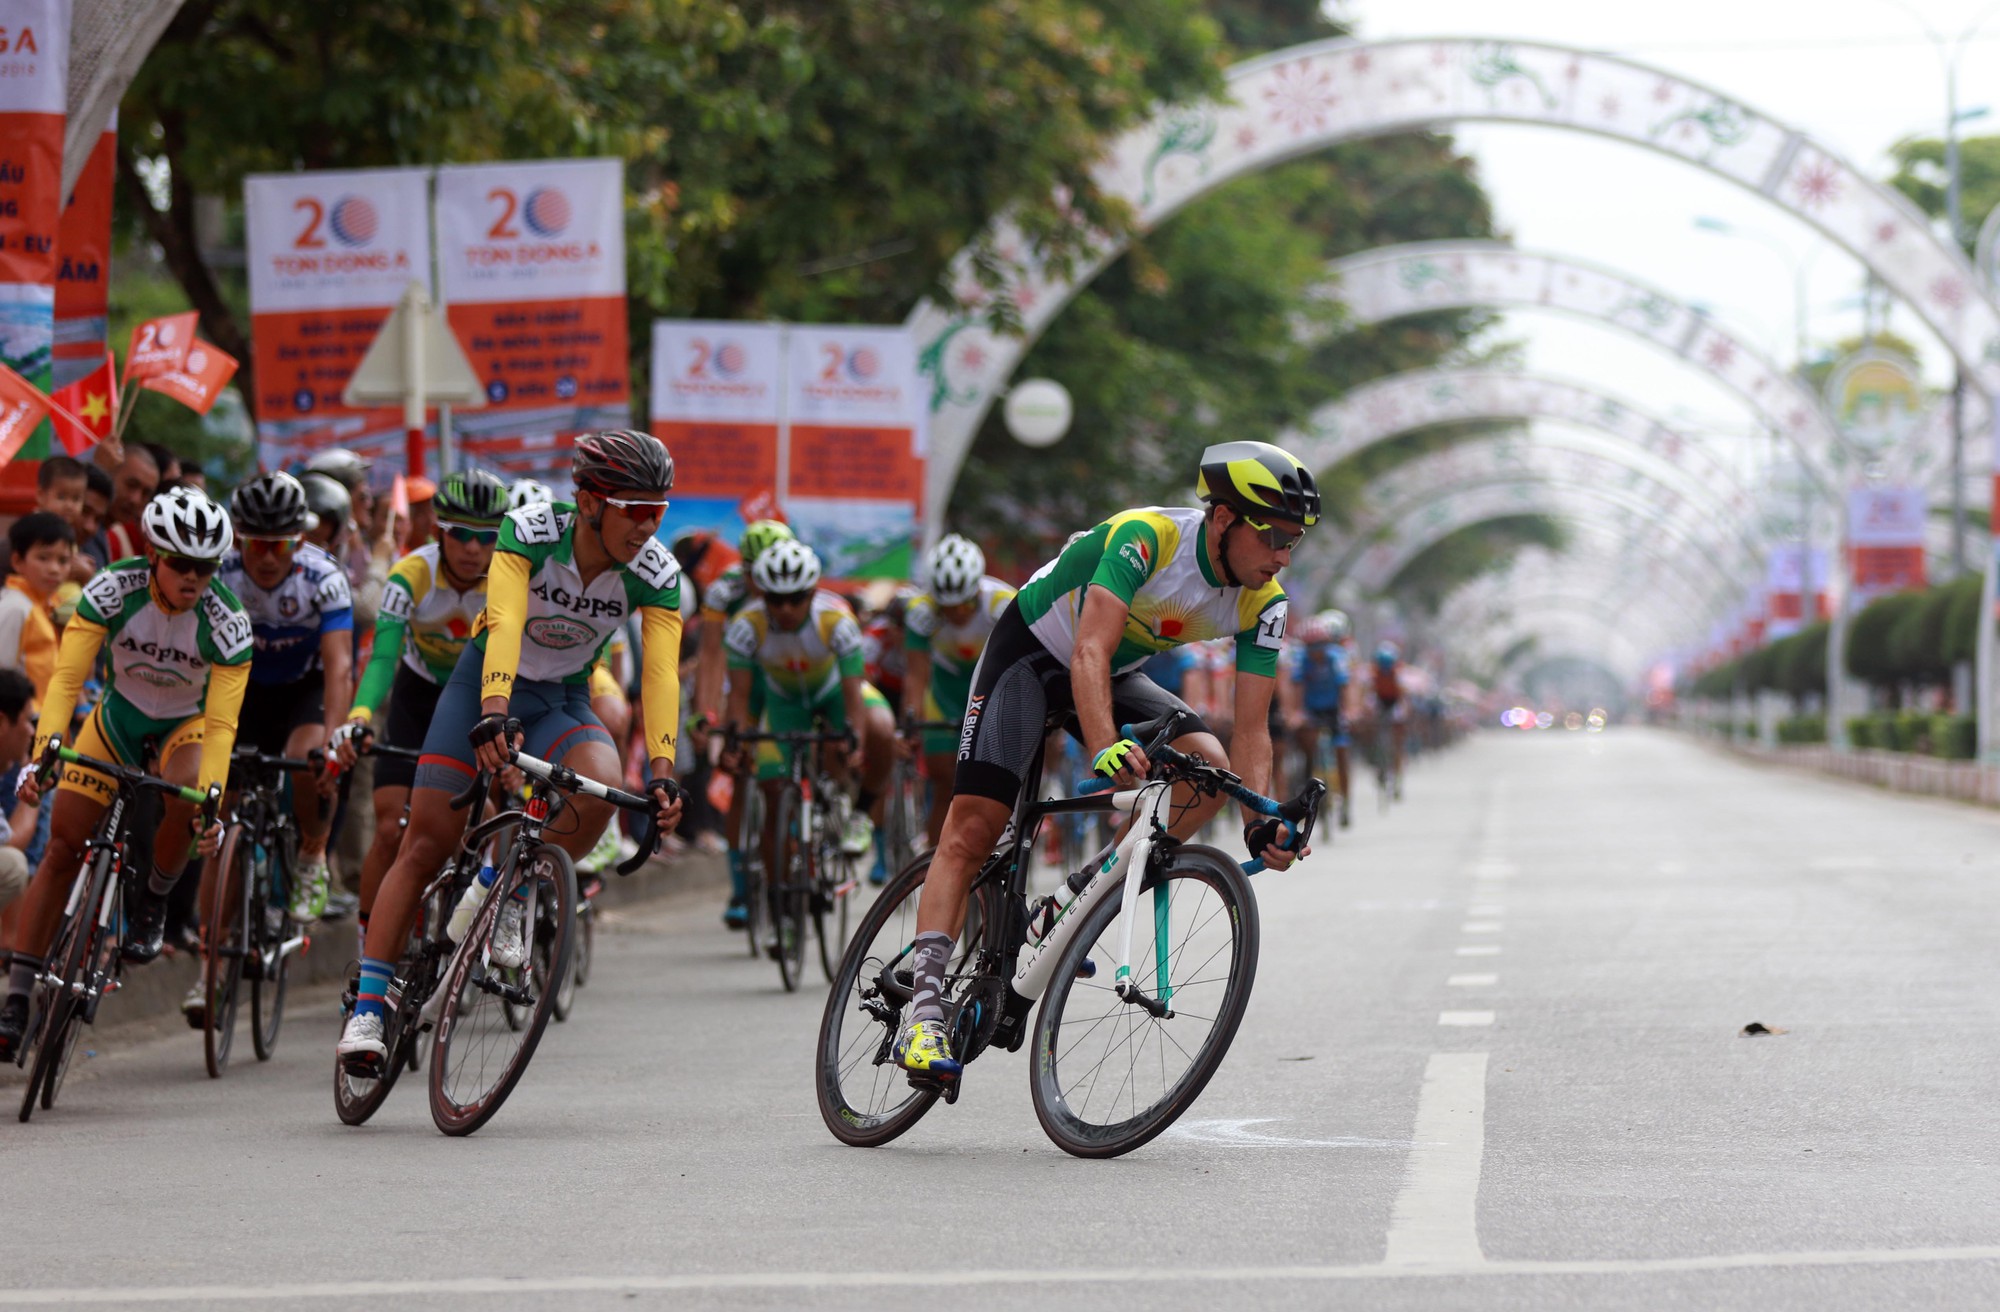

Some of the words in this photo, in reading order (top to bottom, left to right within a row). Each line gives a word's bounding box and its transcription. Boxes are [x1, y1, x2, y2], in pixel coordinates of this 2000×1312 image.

[88, 577, 122, 616] 122
[531, 581, 623, 618] AGPPS
[218, 616, 252, 651] 122
[119, 637, 204, 669] AGPPS
